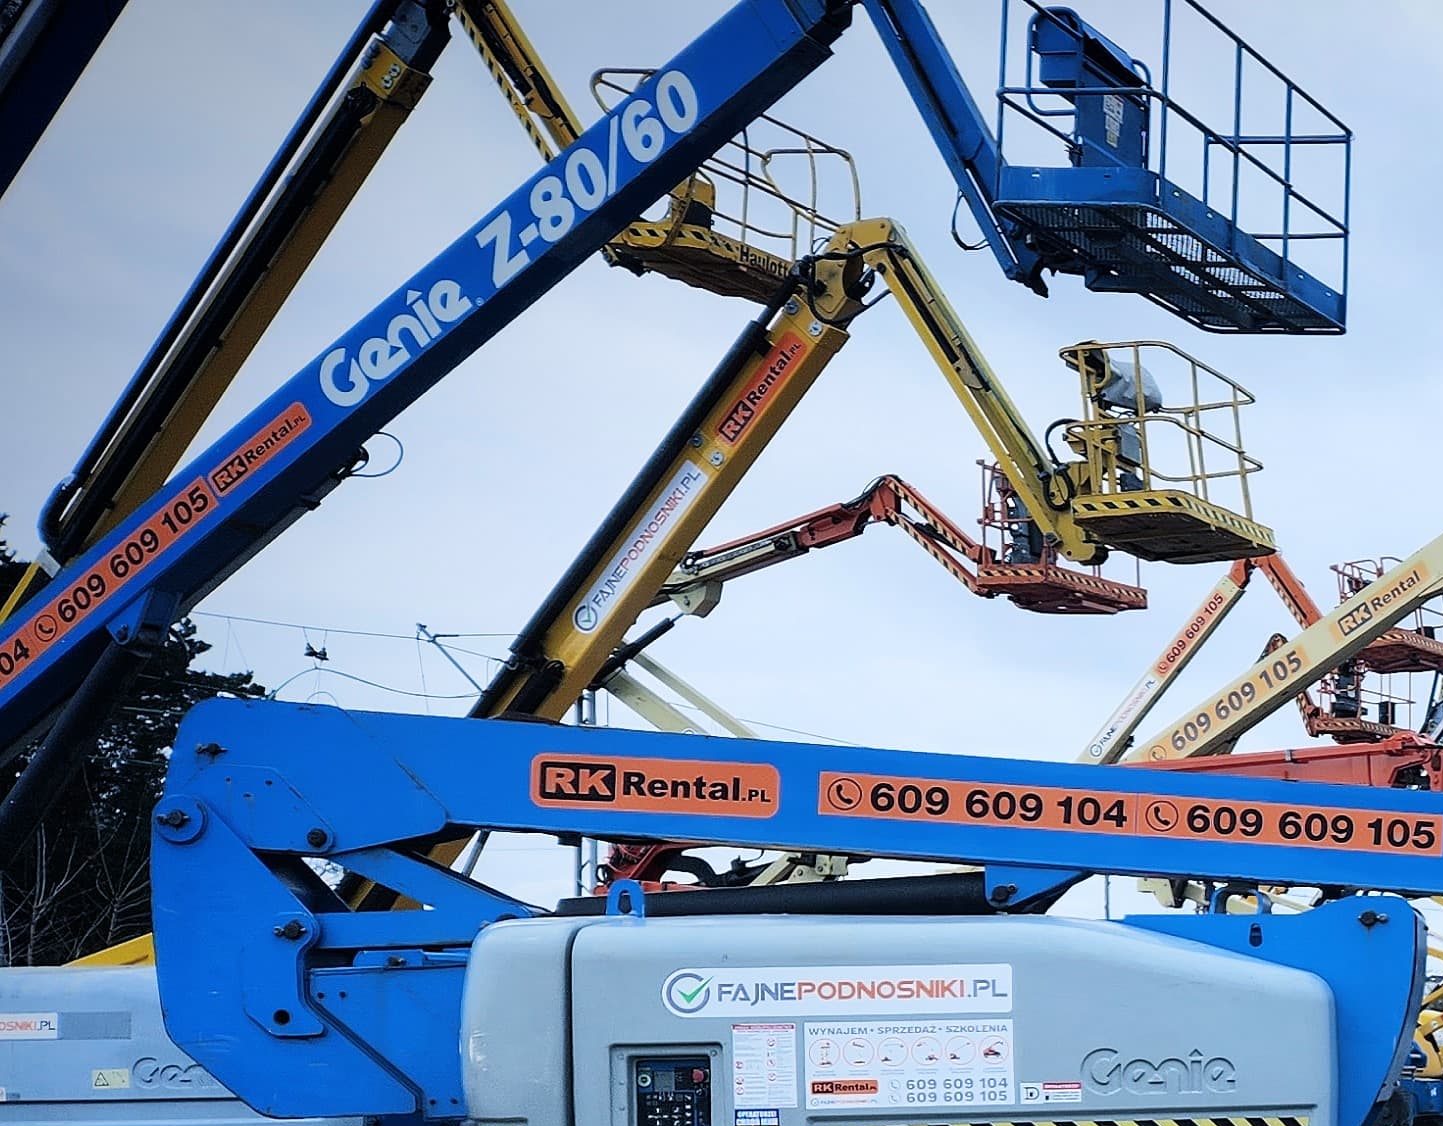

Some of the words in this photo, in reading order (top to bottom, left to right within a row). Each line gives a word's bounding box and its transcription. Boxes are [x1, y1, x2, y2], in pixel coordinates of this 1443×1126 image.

[319, 279, 473, 407] Genie
[475, 70, 699, 288] Z-80/60
[740, 244, 789, 278] Haulott
[57, 573, 106, 623] 609
[109, 528, 159, 578] 609
[161, 486, 209, 535] 105
[1371, 569, 1421, 619] Rental
[1166, 639, 1187, 663] 609
[1185, 615, 1206, 639] 609
[1204, 592, 1224, 616] 105
[1171, 711, 1211, 751] 609
[1215, 681, 1256, 720] 609
[1259, 650, 1302, 689] 105
[870, 783, 949, 816] 609
[966, 788, 1044, 821] 609
[1062, 796, 1128, 829] 104
[1186, 805, 1263, 838] 609
[1278, 812, 1354, 845] 609
[1366, 817, 1437, 850] 105
[717, 977, 1008, 1007] FAJNEPODNOSNIKI.PL
[809, 1027, 868, 1036] WYNAJEM
[945, 1024, 1008, 1033] SZKOLENIA
[906, 1079, 937, 1090] 609
[943, 1078, 973, 1089] 609
[979, 1077, 1008, 1088] 104
[1080, 1048, 1236, 1096] Genie
[906, 1092, 937, 1103] 609
[943, 1091, 974, 1102] 609
[980, 1090, 1008, 1101] 105
